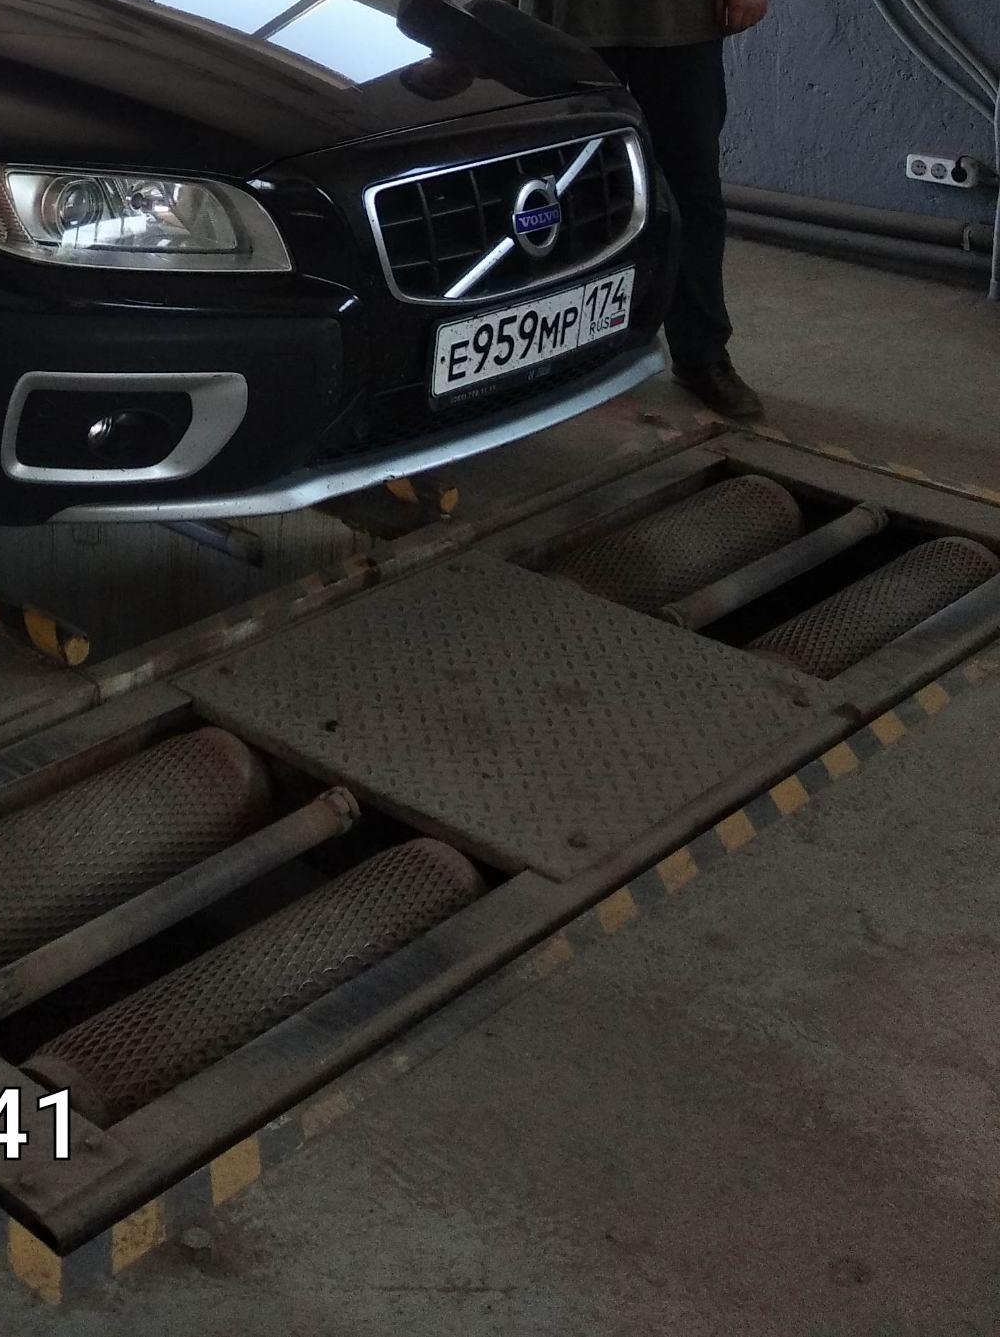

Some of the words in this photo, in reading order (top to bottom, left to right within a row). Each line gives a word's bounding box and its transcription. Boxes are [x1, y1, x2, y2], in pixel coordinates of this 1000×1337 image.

[518, 210, 560, 228] VOLVO
[586, 276, 626, 322] 174
[589, 315, 610, 336] RUS
